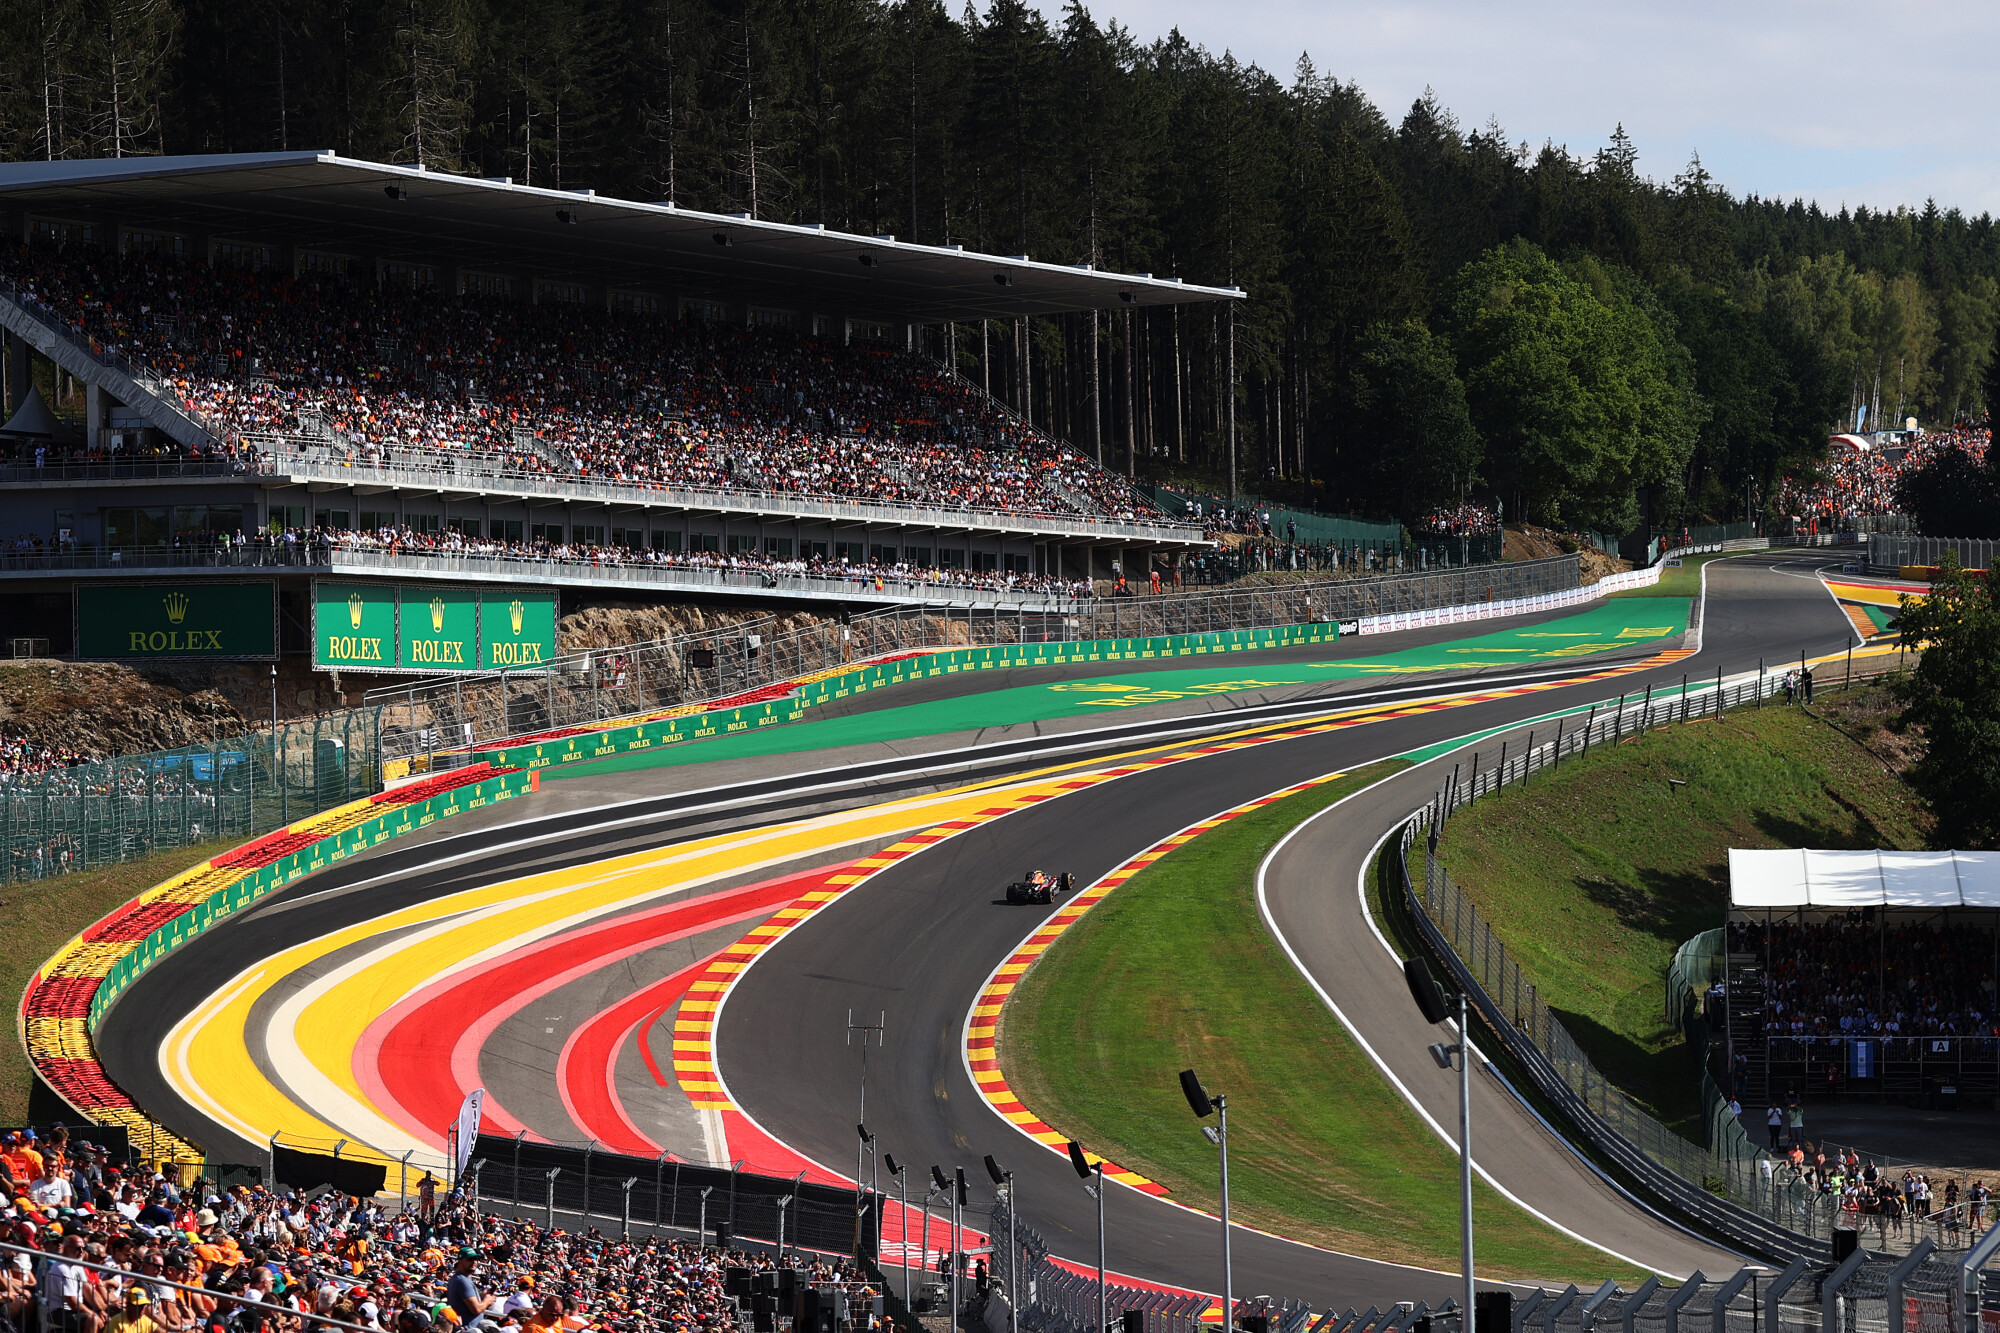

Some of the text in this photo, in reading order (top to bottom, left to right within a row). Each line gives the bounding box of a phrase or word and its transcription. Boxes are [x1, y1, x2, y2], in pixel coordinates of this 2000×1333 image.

[129, 630, 222, 651] ROLEX
[329, 636, 382, 660] ROLEX
[412, 640, 464, 663] ROLEX
[492, 642, 541, 664] ROLEX
[789, 710, 803, 720] ROLEX
[759, 716, 778, 725] ROLEX
[728, 721, 747, 731] ROLEX
[695, 727, 715, 737] ROLEX
[663, 733, 683, 743] ROLEX
[629, 739, 650, 749] ROLEX
[595, 745, 615, 755] ROLEX
[563, 751, 582, 762] ROLEX
[529, 758, 550, 768] ROLEX
[521, 784, 531, 793] ROL
[1936, 1041, 1945, 1050] A
